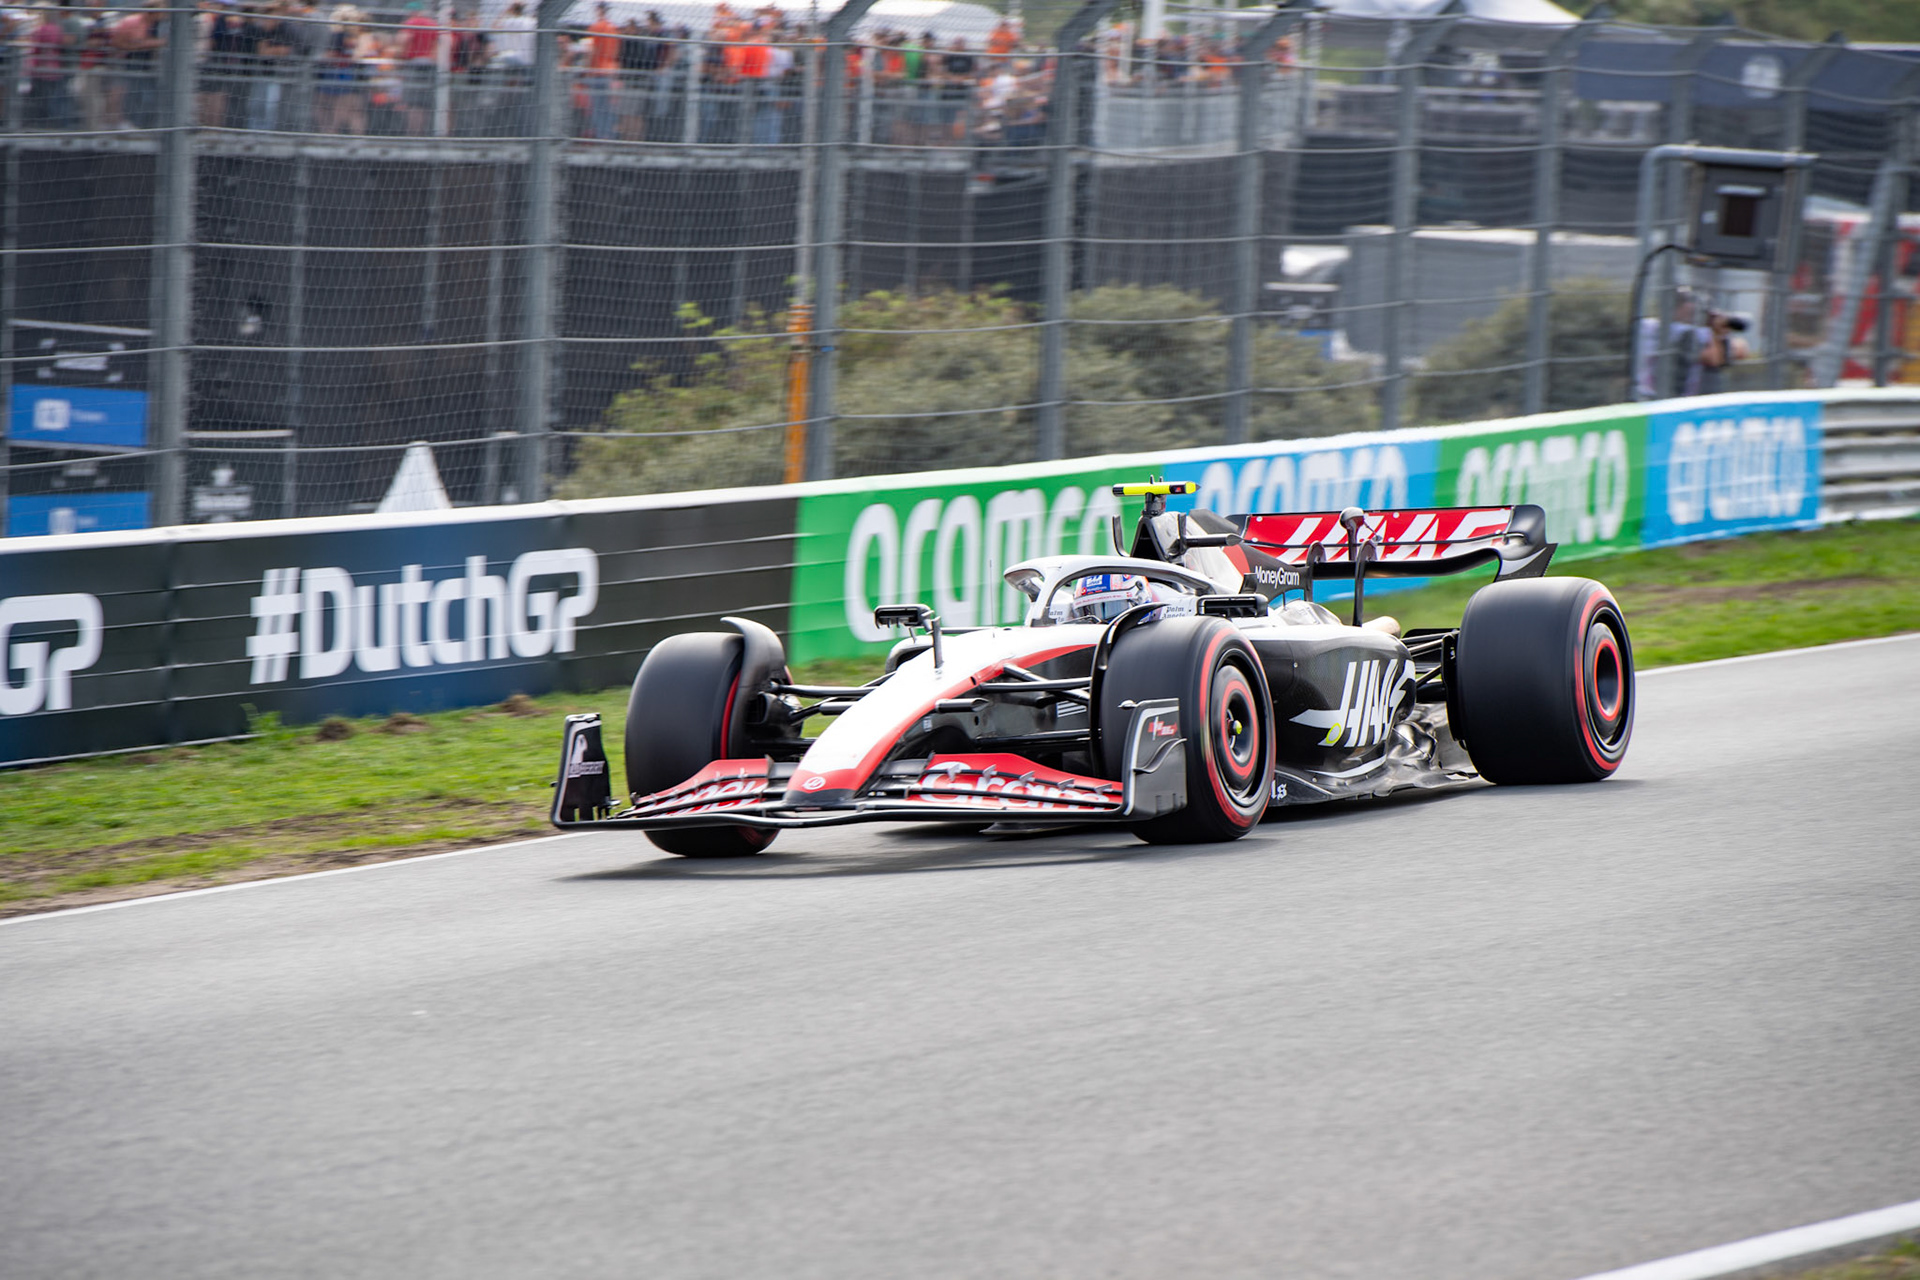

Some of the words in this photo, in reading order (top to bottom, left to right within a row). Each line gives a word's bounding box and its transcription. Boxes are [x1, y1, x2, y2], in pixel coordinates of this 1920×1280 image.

[246, 547, 599, 683] #DutchGP
[847, 486, 1123, 642] aramco
[1255, 565, 1299, 589] MoneyGram
[0, 592, 103, 715] GP
